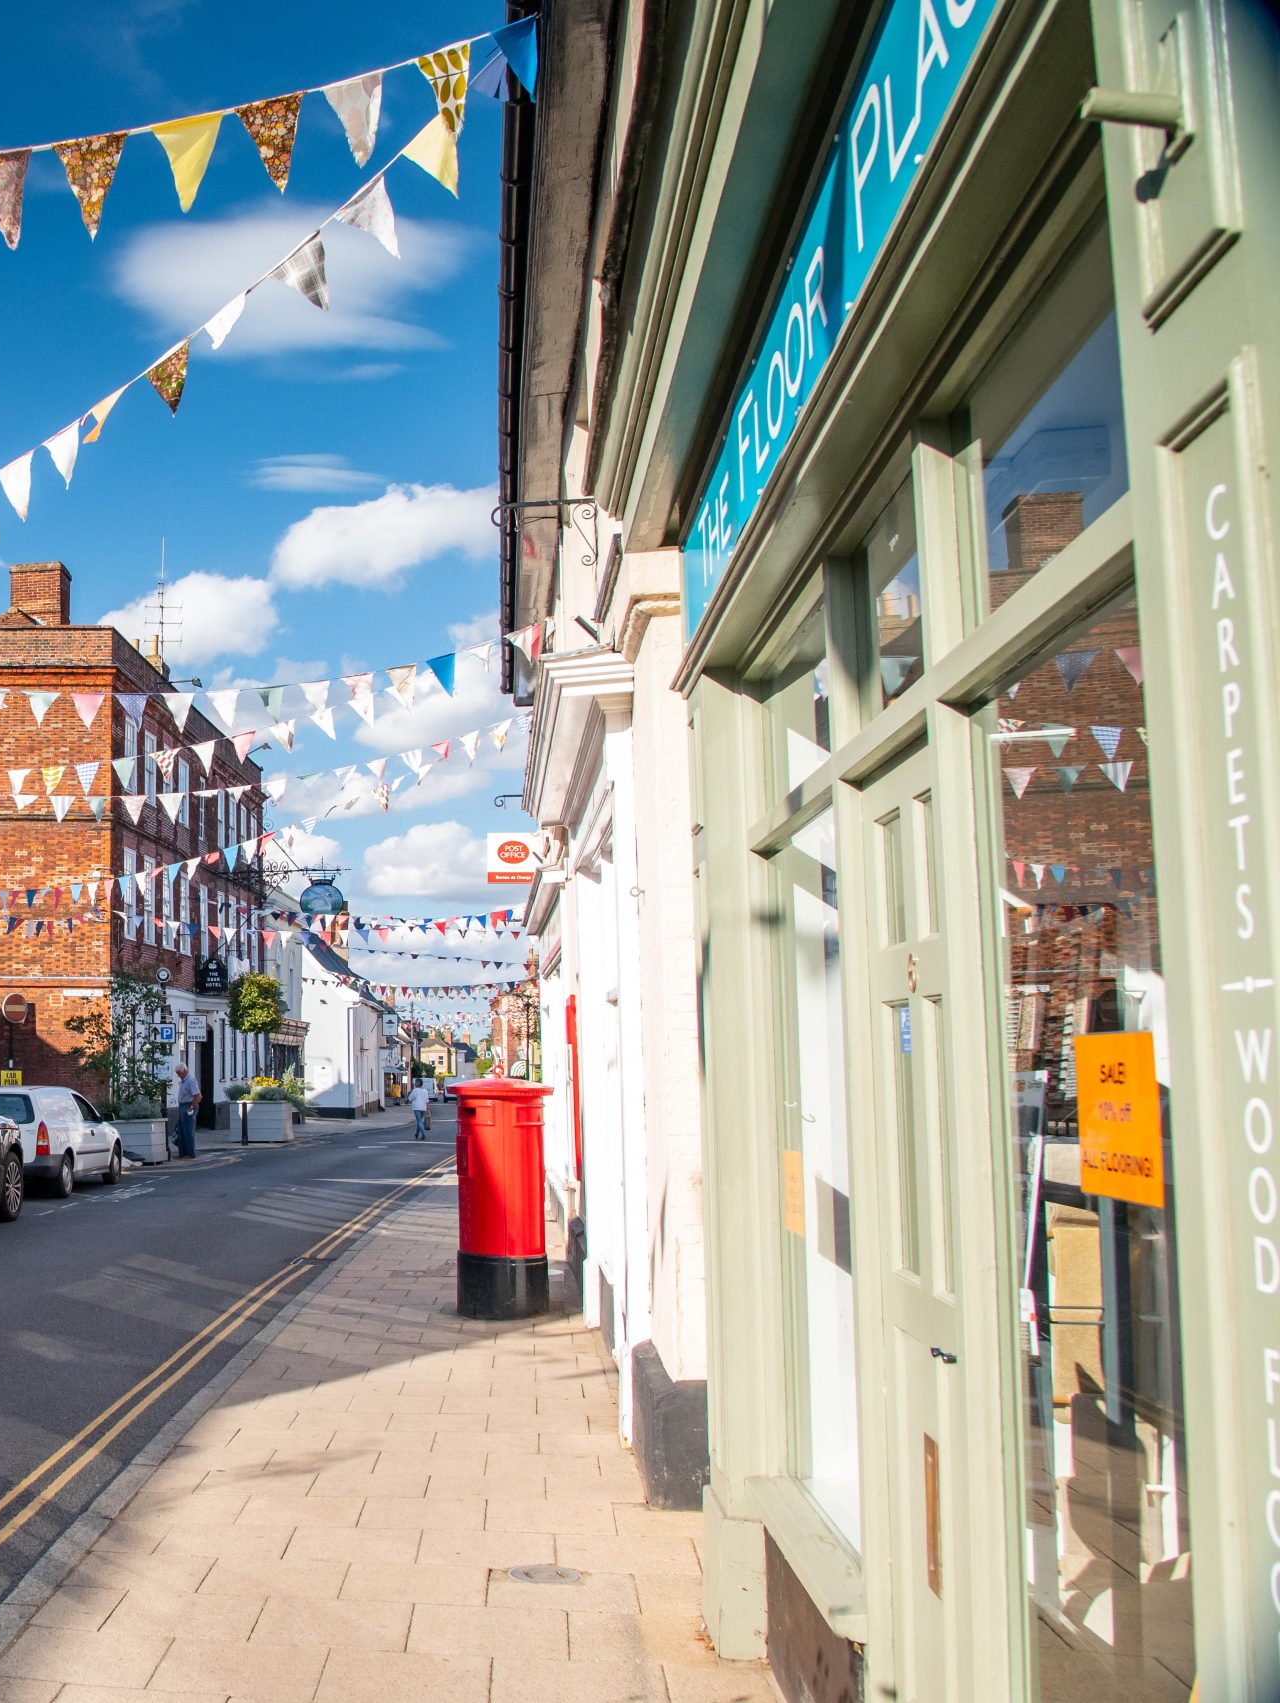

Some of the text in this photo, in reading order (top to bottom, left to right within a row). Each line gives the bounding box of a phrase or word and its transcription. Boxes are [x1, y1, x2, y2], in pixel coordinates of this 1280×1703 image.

[698, 0, 976, 588] THE FLOOR PLA
[1204, 483, 1255, 940] CARPETS
[1234, 1028, 1280, 1294] WOOD
[163, 1029, 171, 1038] P
[1120, 1102, 1132, 1123] off
[1083, 1150, 1099, 1170] ALL
